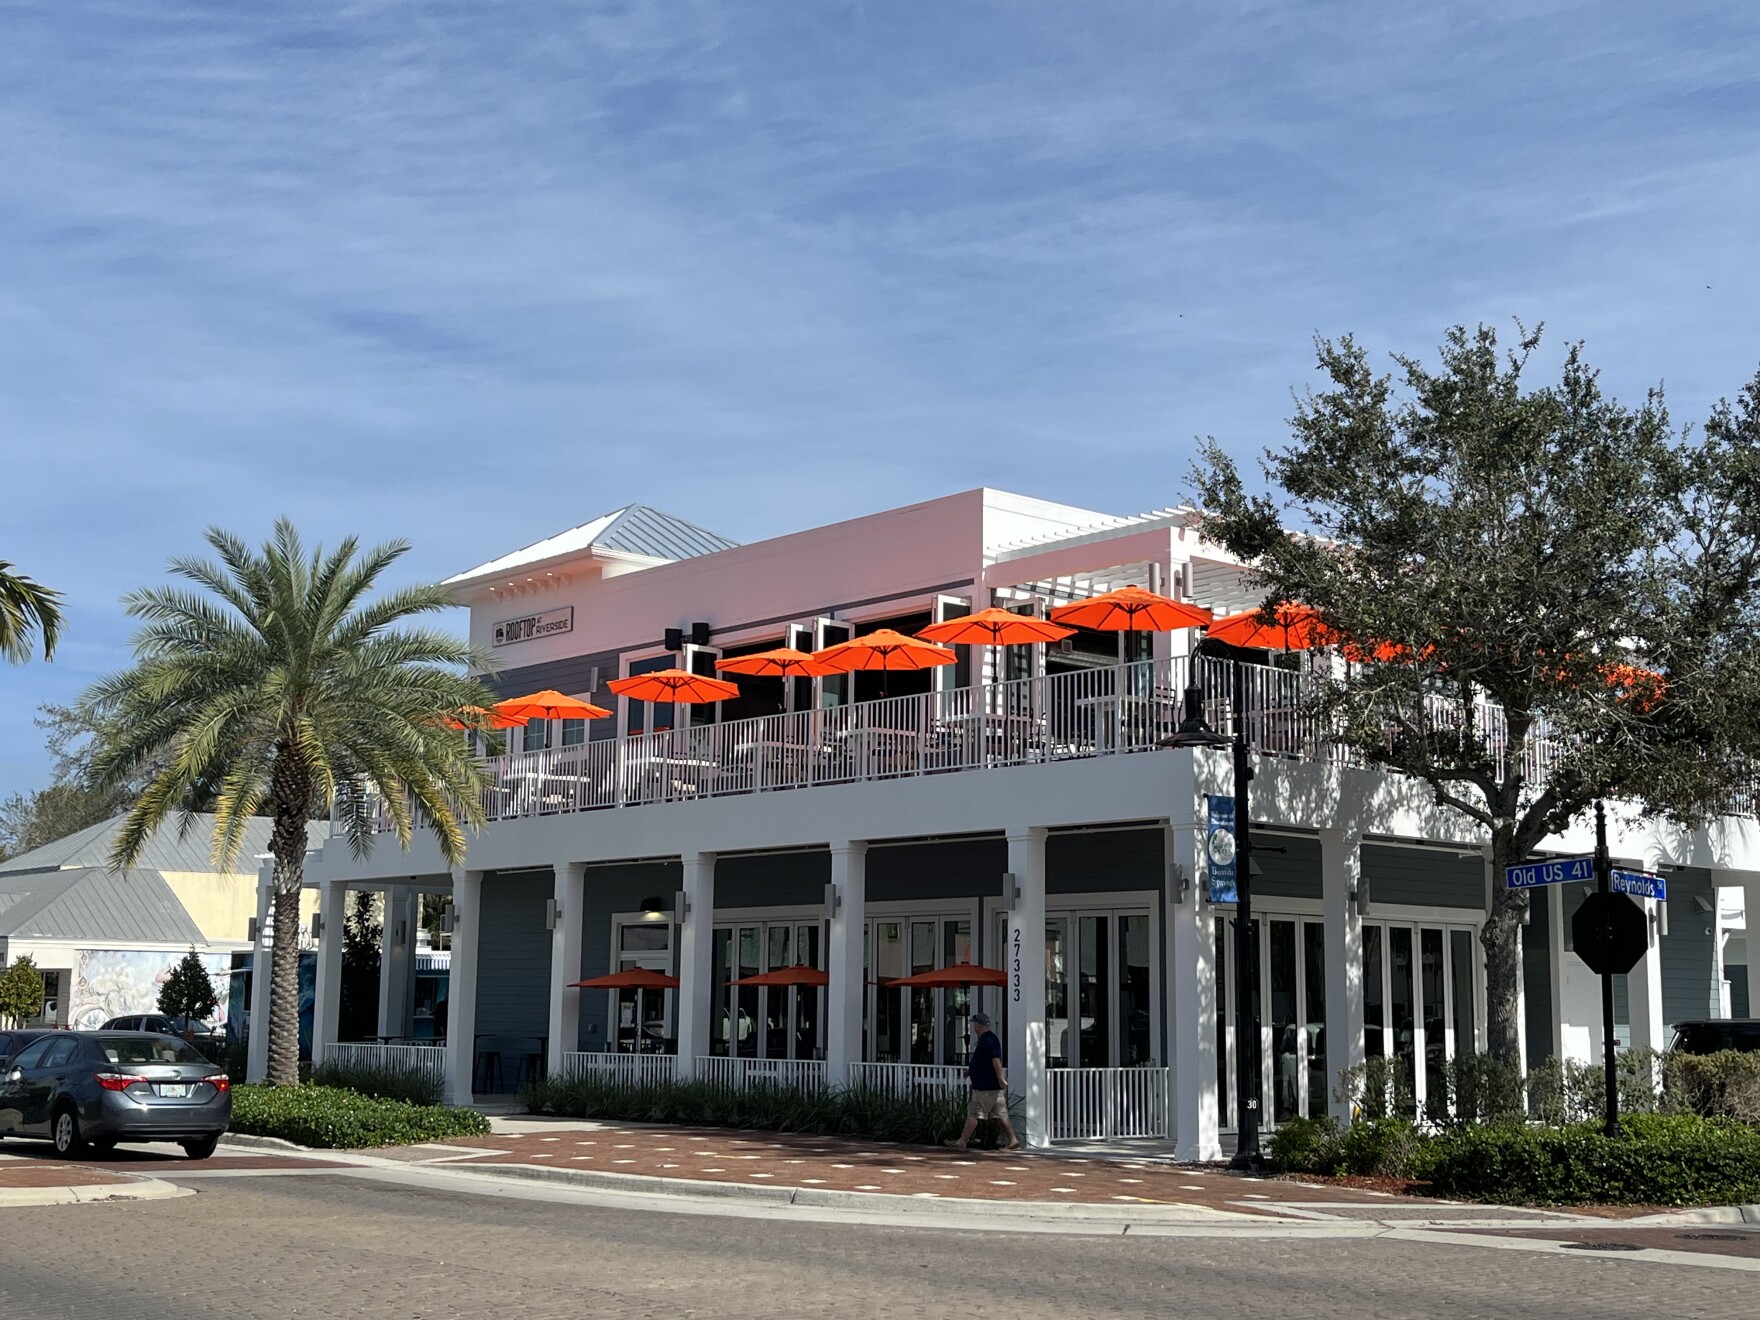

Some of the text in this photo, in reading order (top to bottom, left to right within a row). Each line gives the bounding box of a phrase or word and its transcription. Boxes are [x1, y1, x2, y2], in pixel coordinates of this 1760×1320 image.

[505, 617, 536, 642] ROOFTOP
[536, 616, 542, 624] AT
[536, 619, 569, 634] RIVERSIDE
[1512, 861, 1589, 886] Old US 41
[1613, 874, 1655, 896] Reynolds
[1013, 928, 1021, 1002] 27333
[1247, 1100, 1257, 1109] 30
